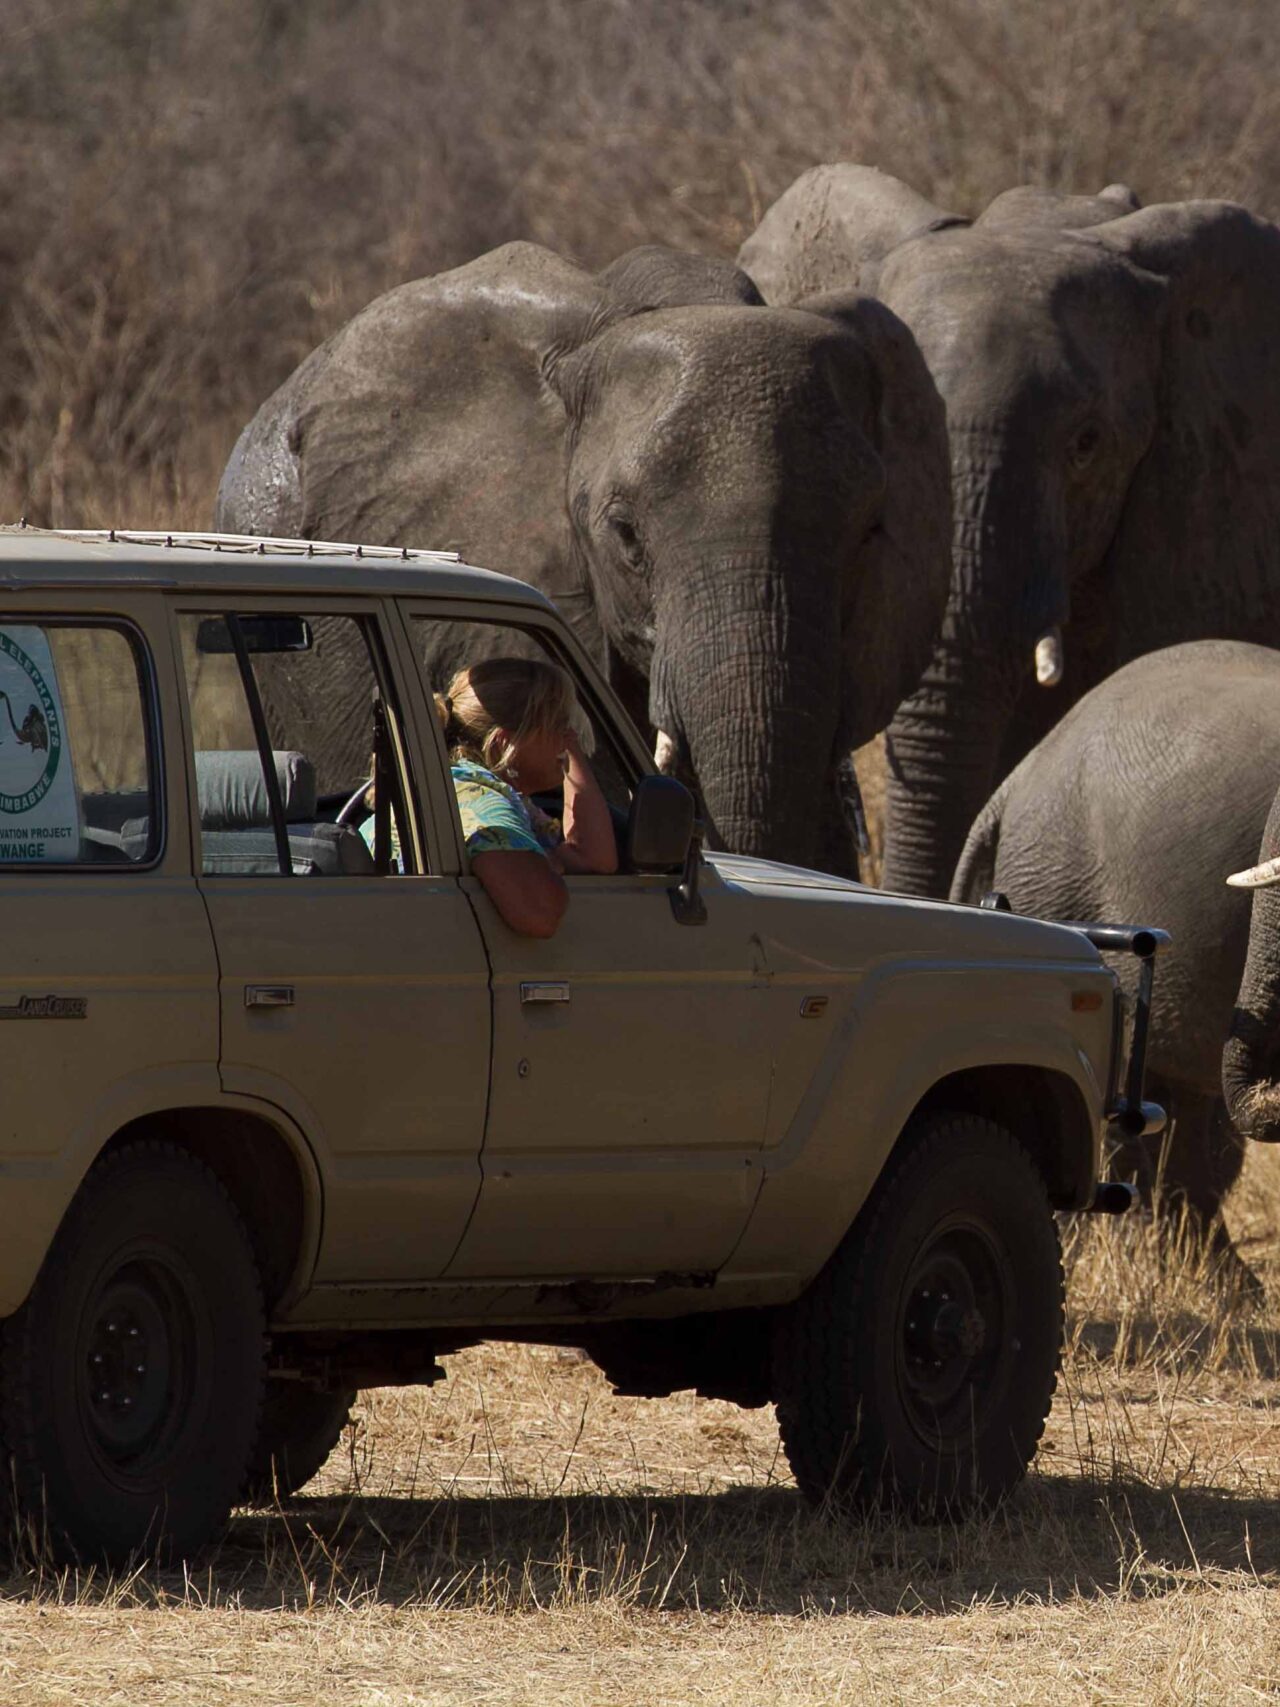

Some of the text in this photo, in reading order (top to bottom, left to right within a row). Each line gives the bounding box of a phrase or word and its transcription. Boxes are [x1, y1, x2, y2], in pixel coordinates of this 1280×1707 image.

[9, 643, 60, 748] ELEPHANTS
[31, 827, 72, 839] PROJECT
[0, 843, 45, 858] WANGE
